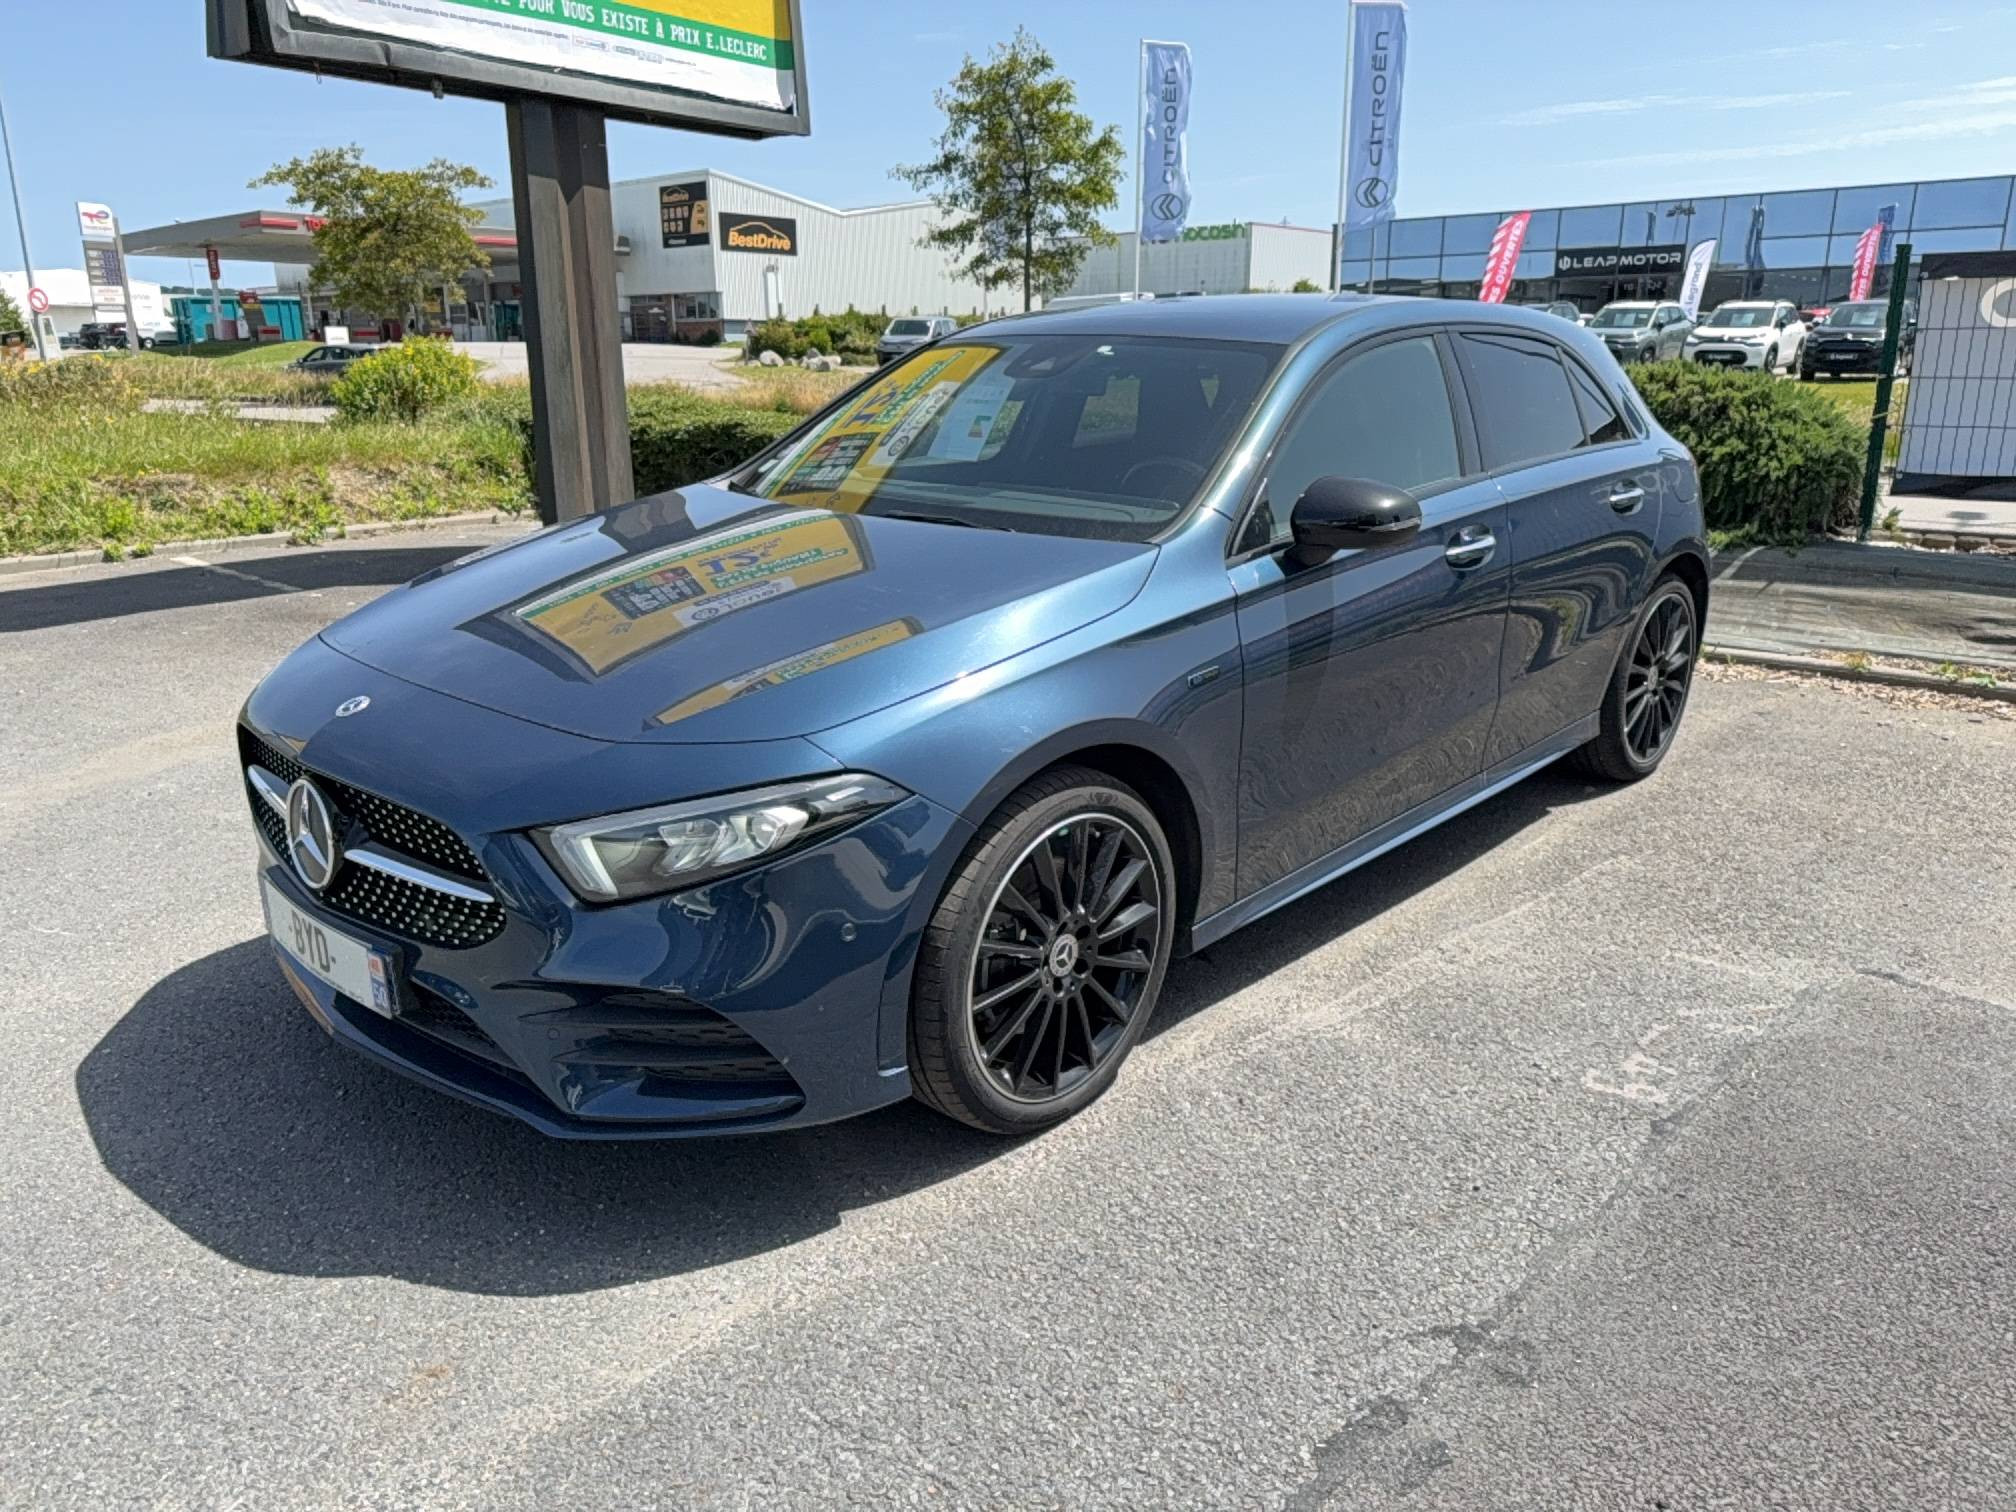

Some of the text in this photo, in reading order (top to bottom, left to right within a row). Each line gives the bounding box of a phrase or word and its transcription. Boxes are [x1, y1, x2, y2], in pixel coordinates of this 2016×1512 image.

[561, 0, 595, 23] VOUS
[601, 8, 649, 35] EXISTE
[655, 17, 664, 39] À
[670, 24, 701, 46] PRIX
[706, 32, 767, 61] E.LECLERC
[727, 230, 792, 251] BestDrive
